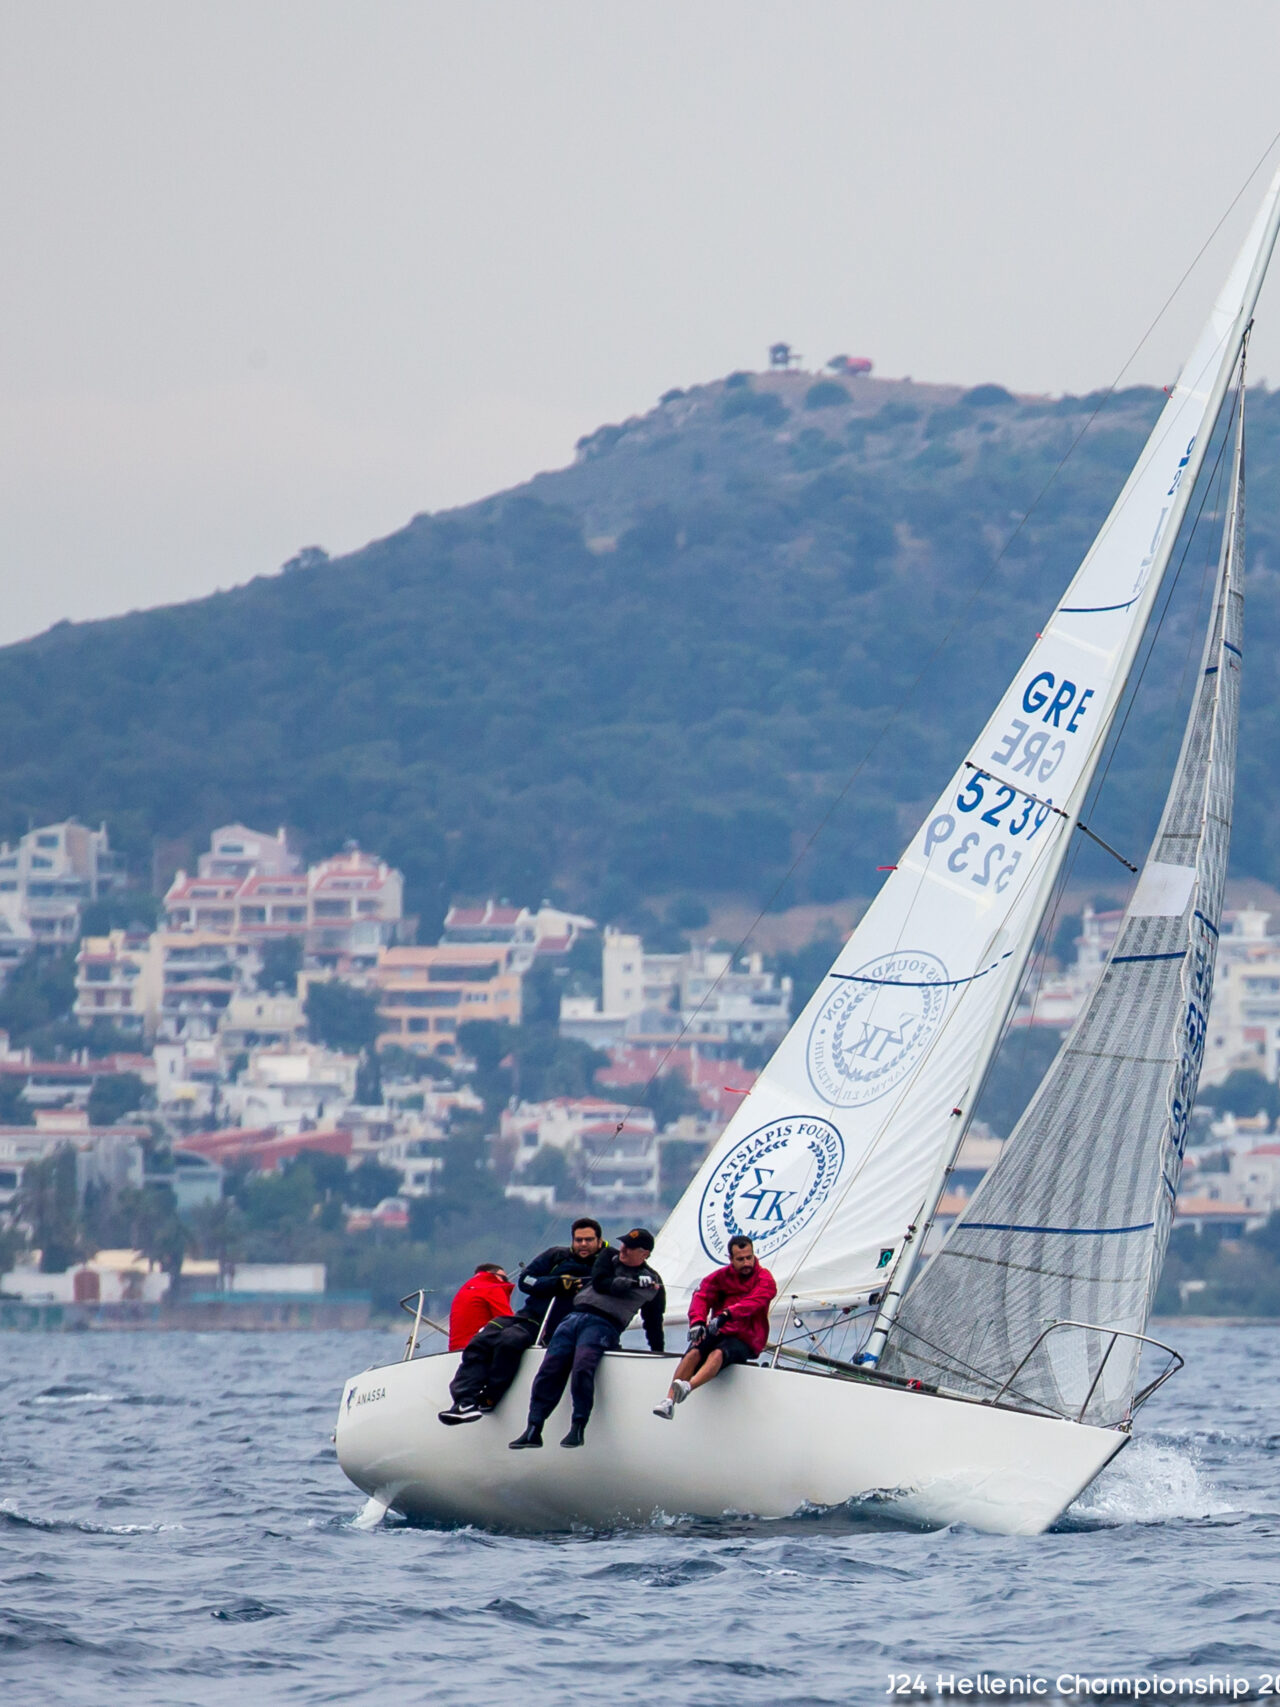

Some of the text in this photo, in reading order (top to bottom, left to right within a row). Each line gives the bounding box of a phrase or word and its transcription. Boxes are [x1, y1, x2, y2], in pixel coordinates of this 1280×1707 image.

[1023, 671, 1094, 733] GRE
[956, 770, 1053, 840] 5239
[713, 1124, 793, 1194] CATSIAPIS
[355, 1387, 386, 1407] ANASSA
